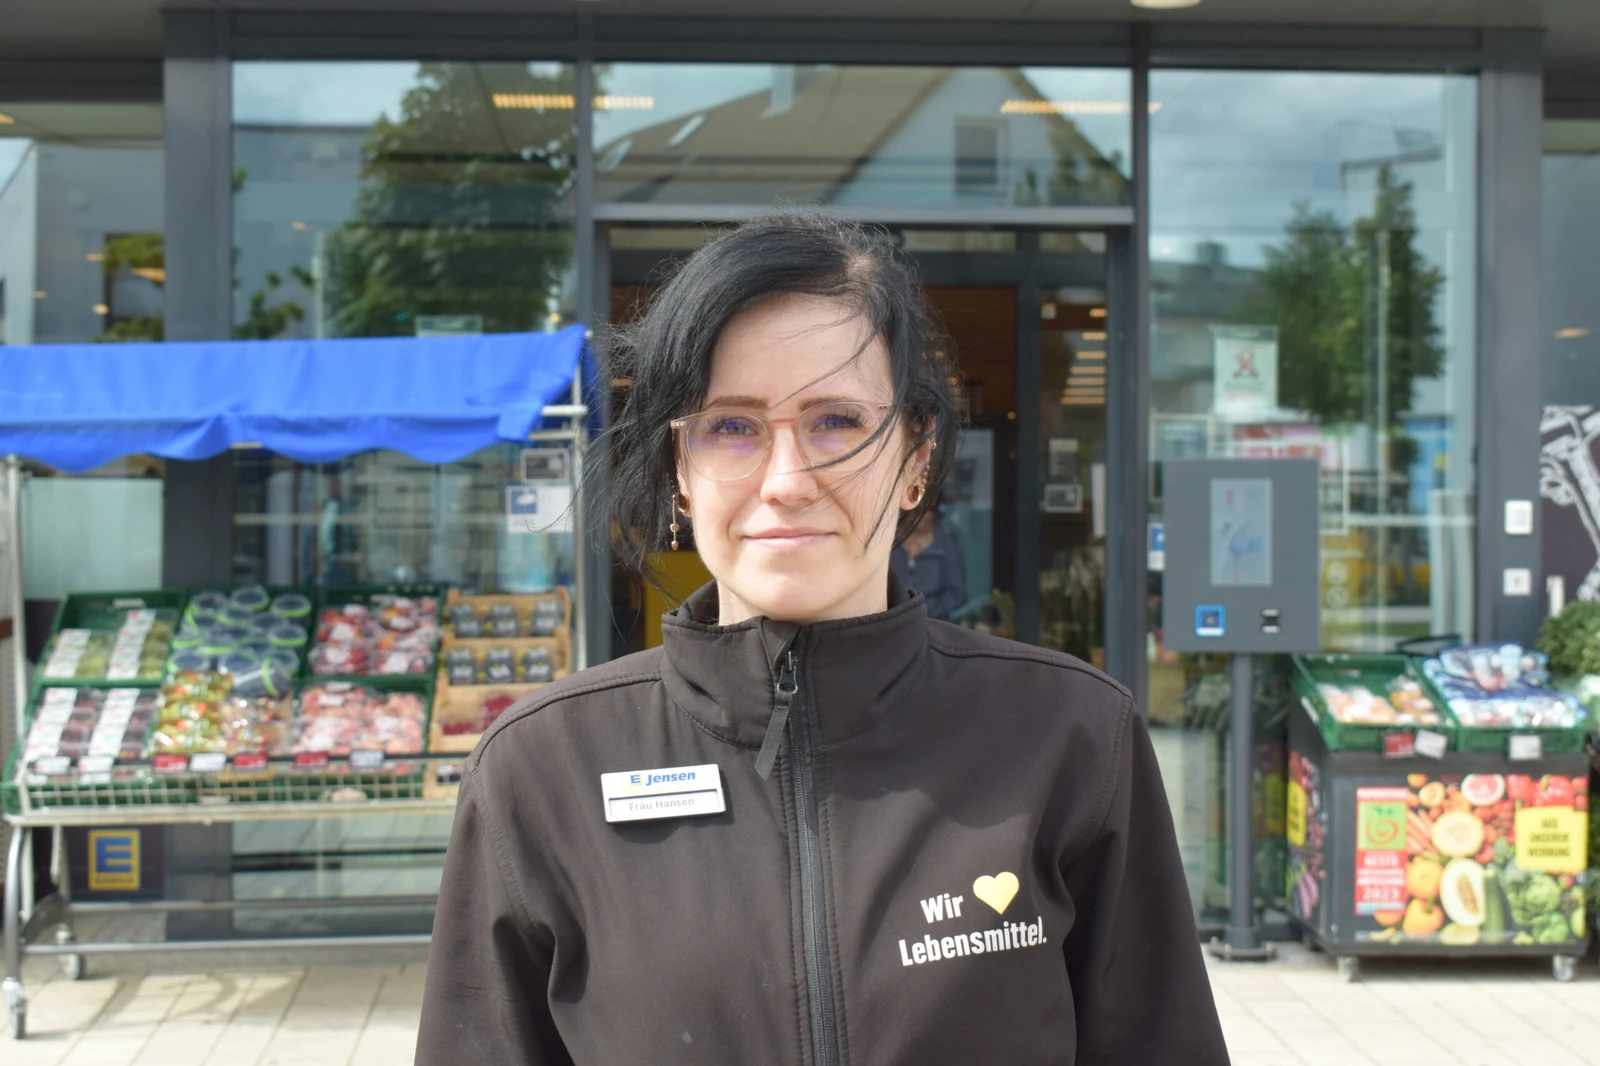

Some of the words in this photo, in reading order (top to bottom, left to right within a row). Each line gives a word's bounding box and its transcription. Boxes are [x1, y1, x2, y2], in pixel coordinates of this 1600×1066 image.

[630, 774, 641, 784] E
[645, 772, 696, 786] Jensen
[629, 802, 653, 811] Frau
[655, 798, 695, 809] Hansen
[96, 837, 132, 873] E
[920, 893, 964, 924] Wir
[899, 916, 1047, 966] Lebensmittel.
